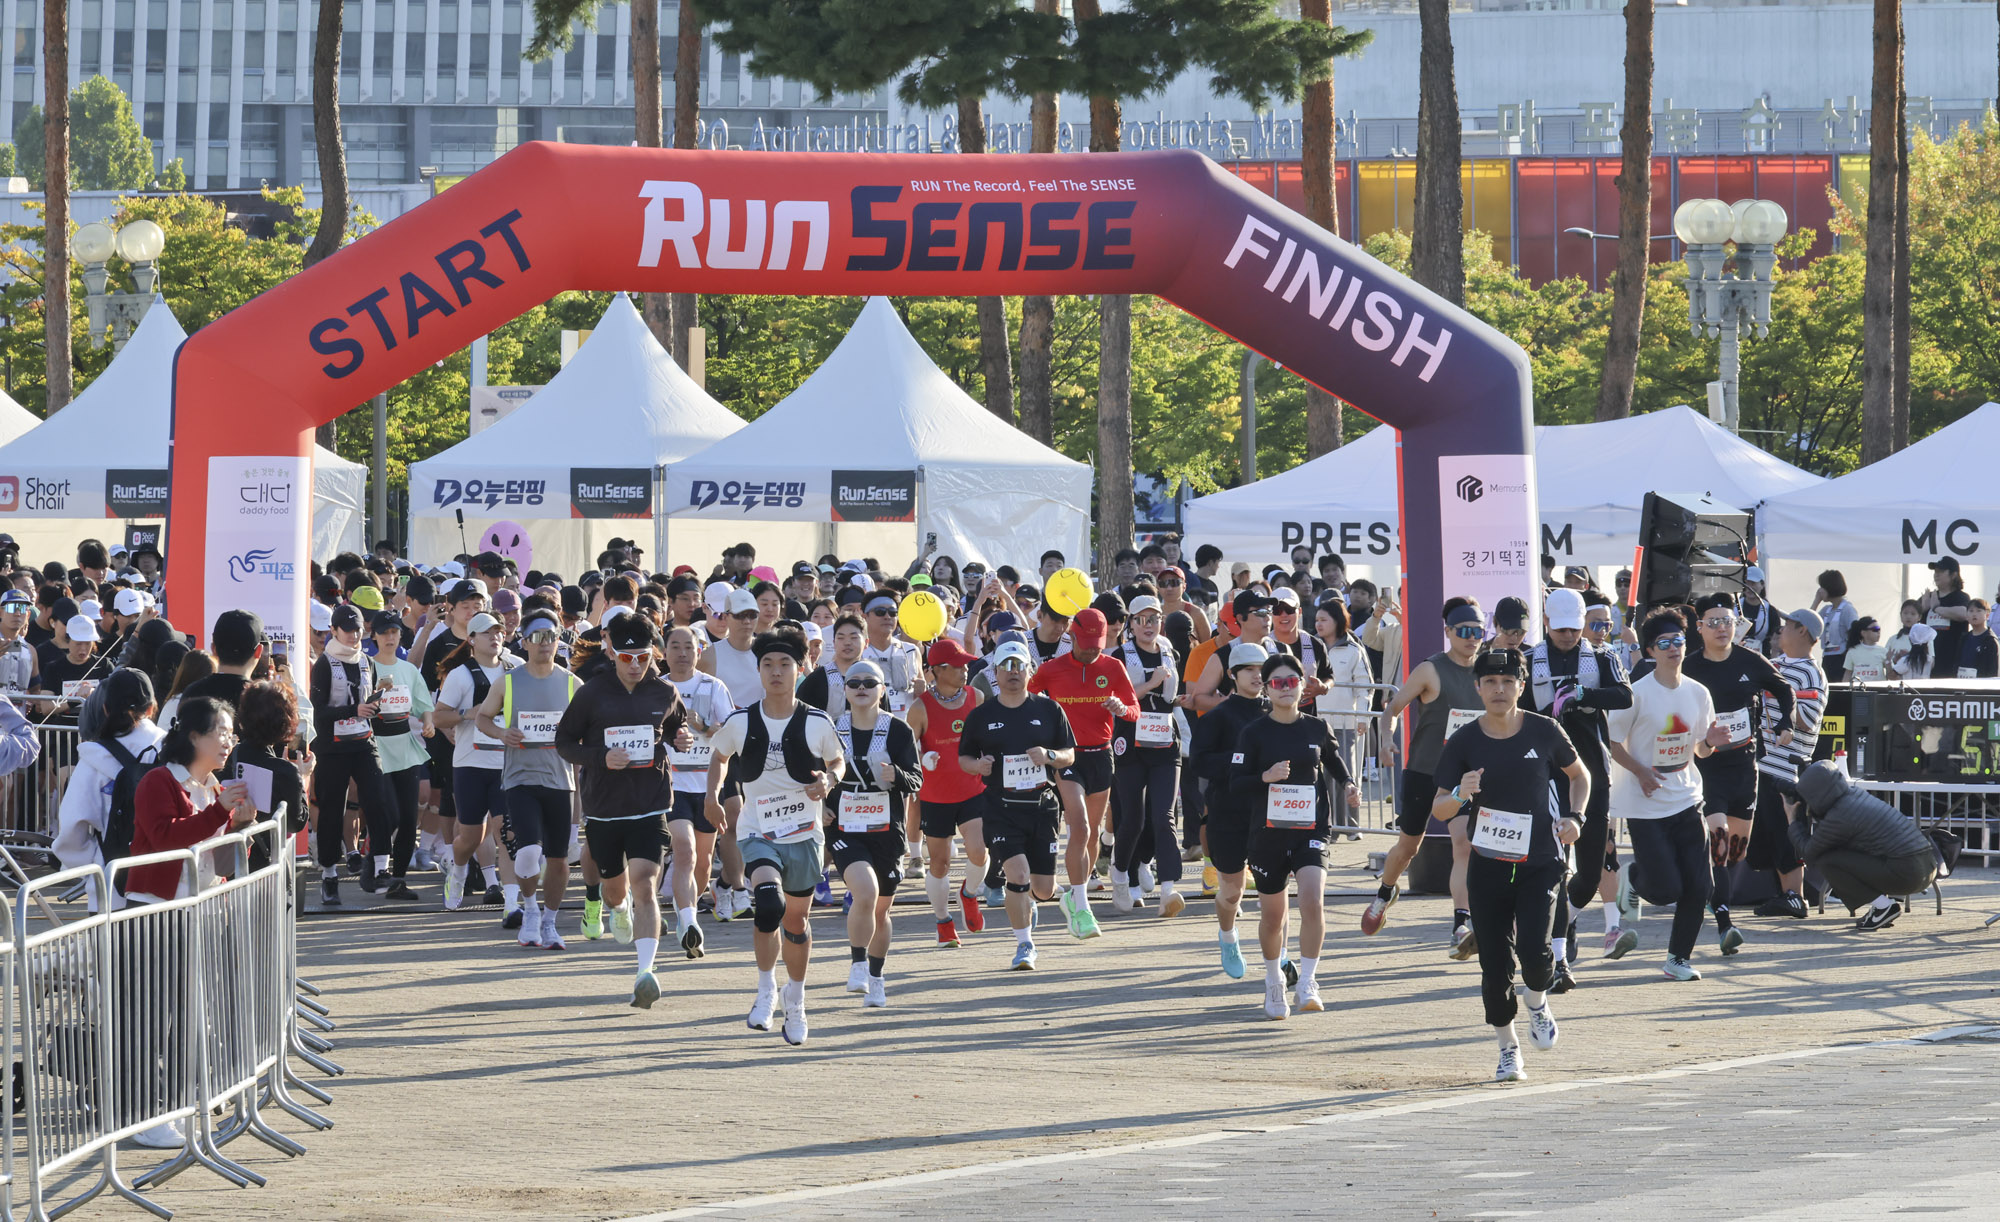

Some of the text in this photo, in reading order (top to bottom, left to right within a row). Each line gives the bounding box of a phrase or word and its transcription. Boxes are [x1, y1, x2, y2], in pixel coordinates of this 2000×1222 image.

[941, 113, 960, 153] &
[910, 179, 1137, 193] RUN The Record, Feel The SENSE
[309, 208, 532, 379] START
[1223, 214, 1453, 383] FINISH
[25, 477, 71, 496] Short
[240, 483, 291, 503] 대디
[463, 480, 546, 512] 오늘덤핑
[720, 481, 806, 514] 오늘덤핑
[239, 506, 289, 516] daddy food
[1281, 521, 1400, 556] PRES
[1901, 518, 1980, 557] MC
[1462, 550, 1526, 568] 경기떡집
[259, 561, 295, 581] 피죤
[262, 632, 295, 644] abitat
[389, 696, 409, 704] 2559
[533, 724, 558, 732] 1083
[1729, 721, 1747, 732] 558
[621, 740, 649, 749] 1475
[687, 746, 710, 755] 173
[1018, 765, 1042, 776] 1113
[764, 811, 772, 819] M
[775, 802, 805, 817] 1799
[855, 805, 884, 813] 2205
[1283, 800, 1311, 809] 2607
[1481, 825, 1523, 841] M 1821
